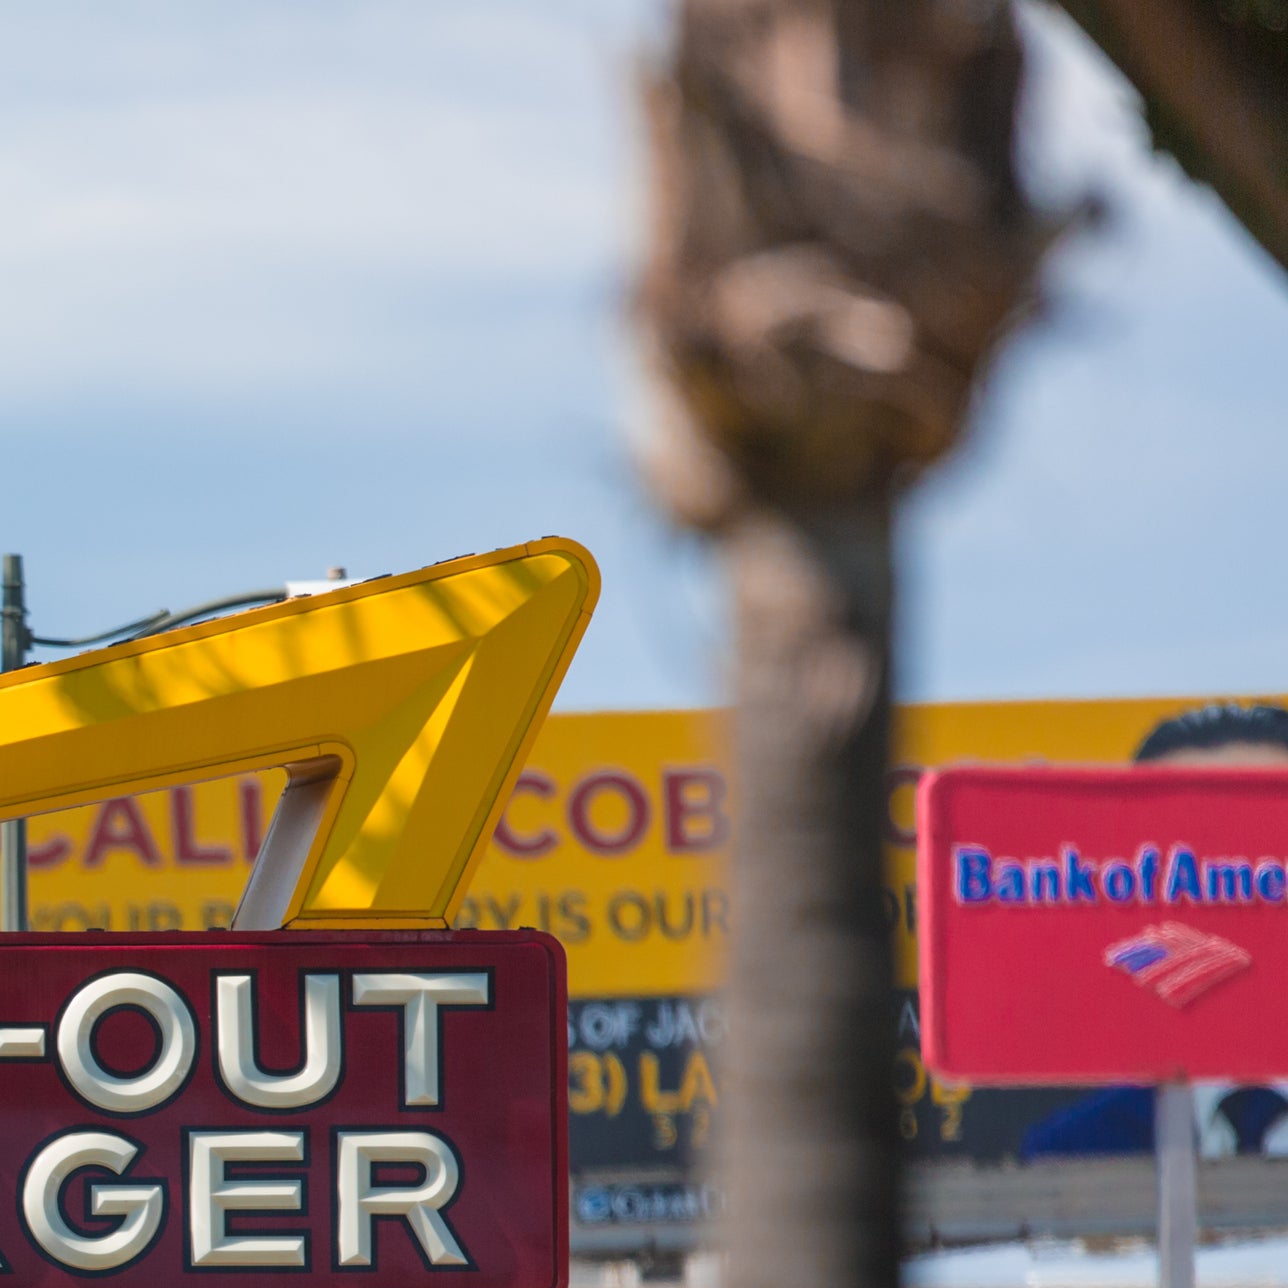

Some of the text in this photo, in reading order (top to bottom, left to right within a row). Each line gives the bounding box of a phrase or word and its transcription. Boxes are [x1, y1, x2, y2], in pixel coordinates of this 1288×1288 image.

[956, 842, 1288, 903] Bank of Ame
